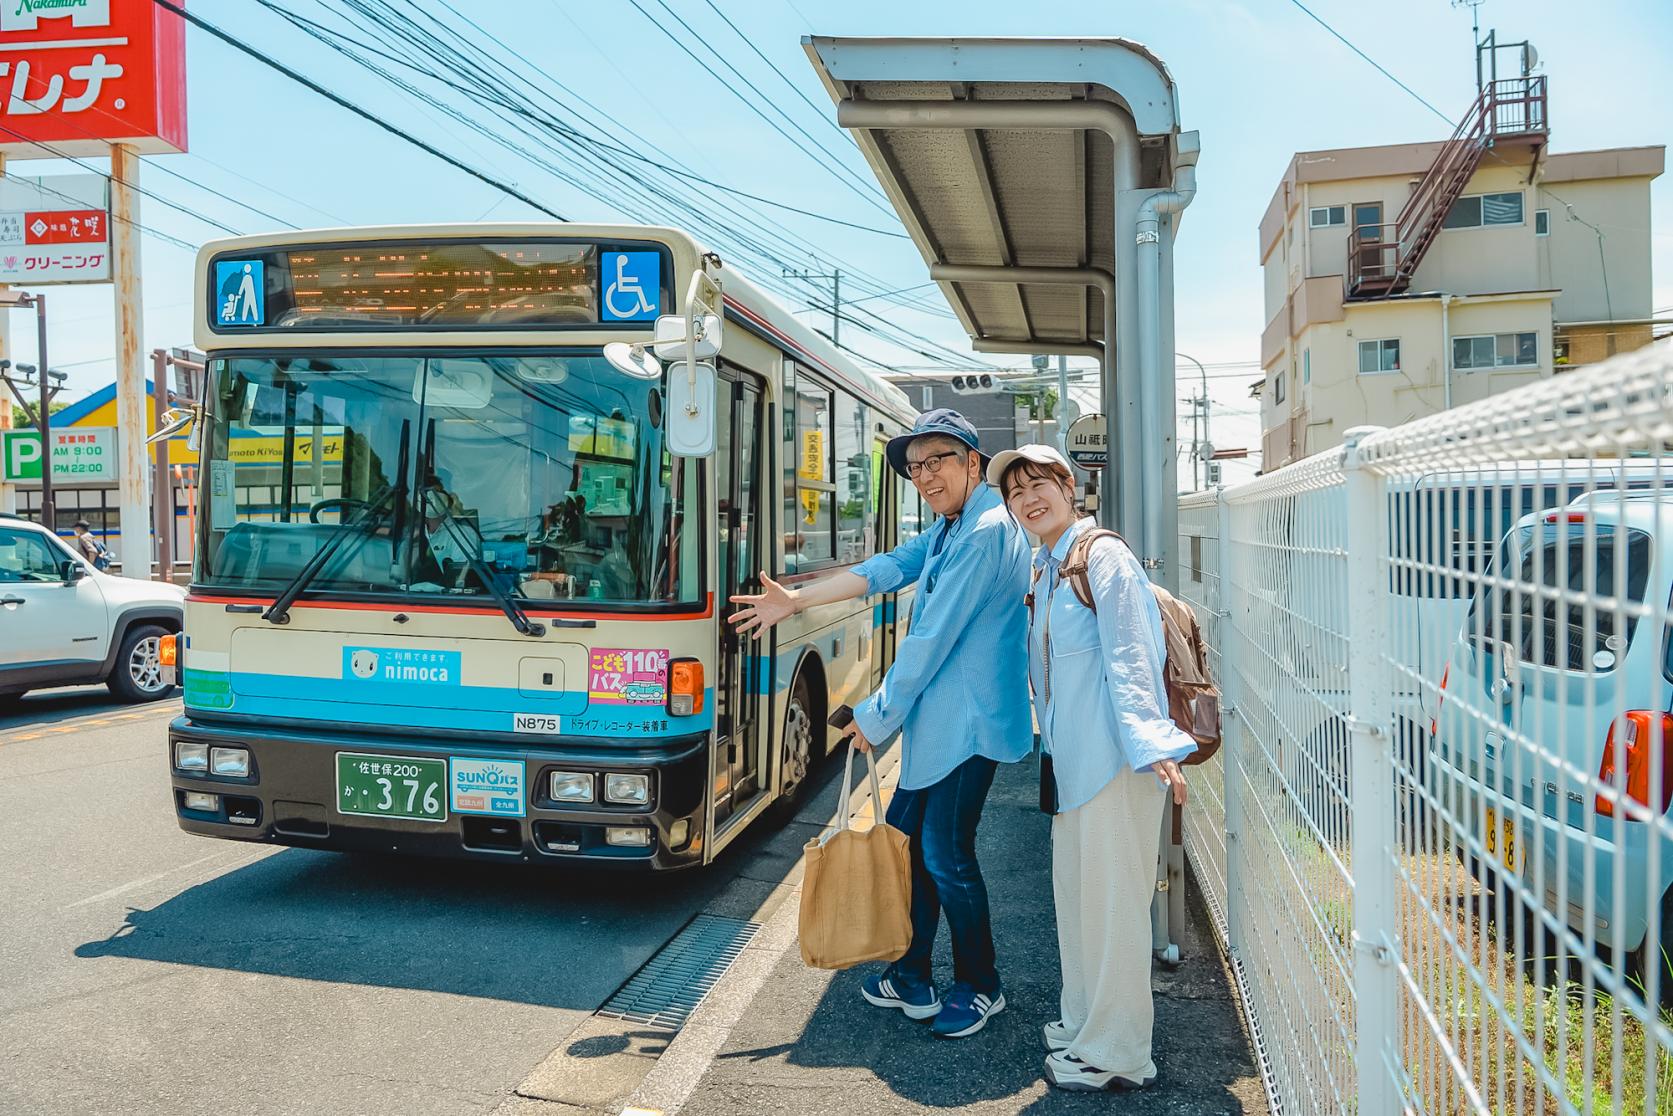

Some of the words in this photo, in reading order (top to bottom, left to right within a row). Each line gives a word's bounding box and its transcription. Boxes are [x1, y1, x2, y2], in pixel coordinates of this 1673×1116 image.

[0, 53, 124, 115] レナ
[24, 254, 105, 270] クリーニング
[11, 437, 42, 477] P
[53, 447, 69, 456] AM
[73, 446, 102, 455] 9:00
[53, 464, 69, 473] PM
[71, 463, 103, 473] 22:00
[385, 661, 449, 682] nimoca
[592, 673, 623, 690] バス
[517, 717, 557, 731] N875
